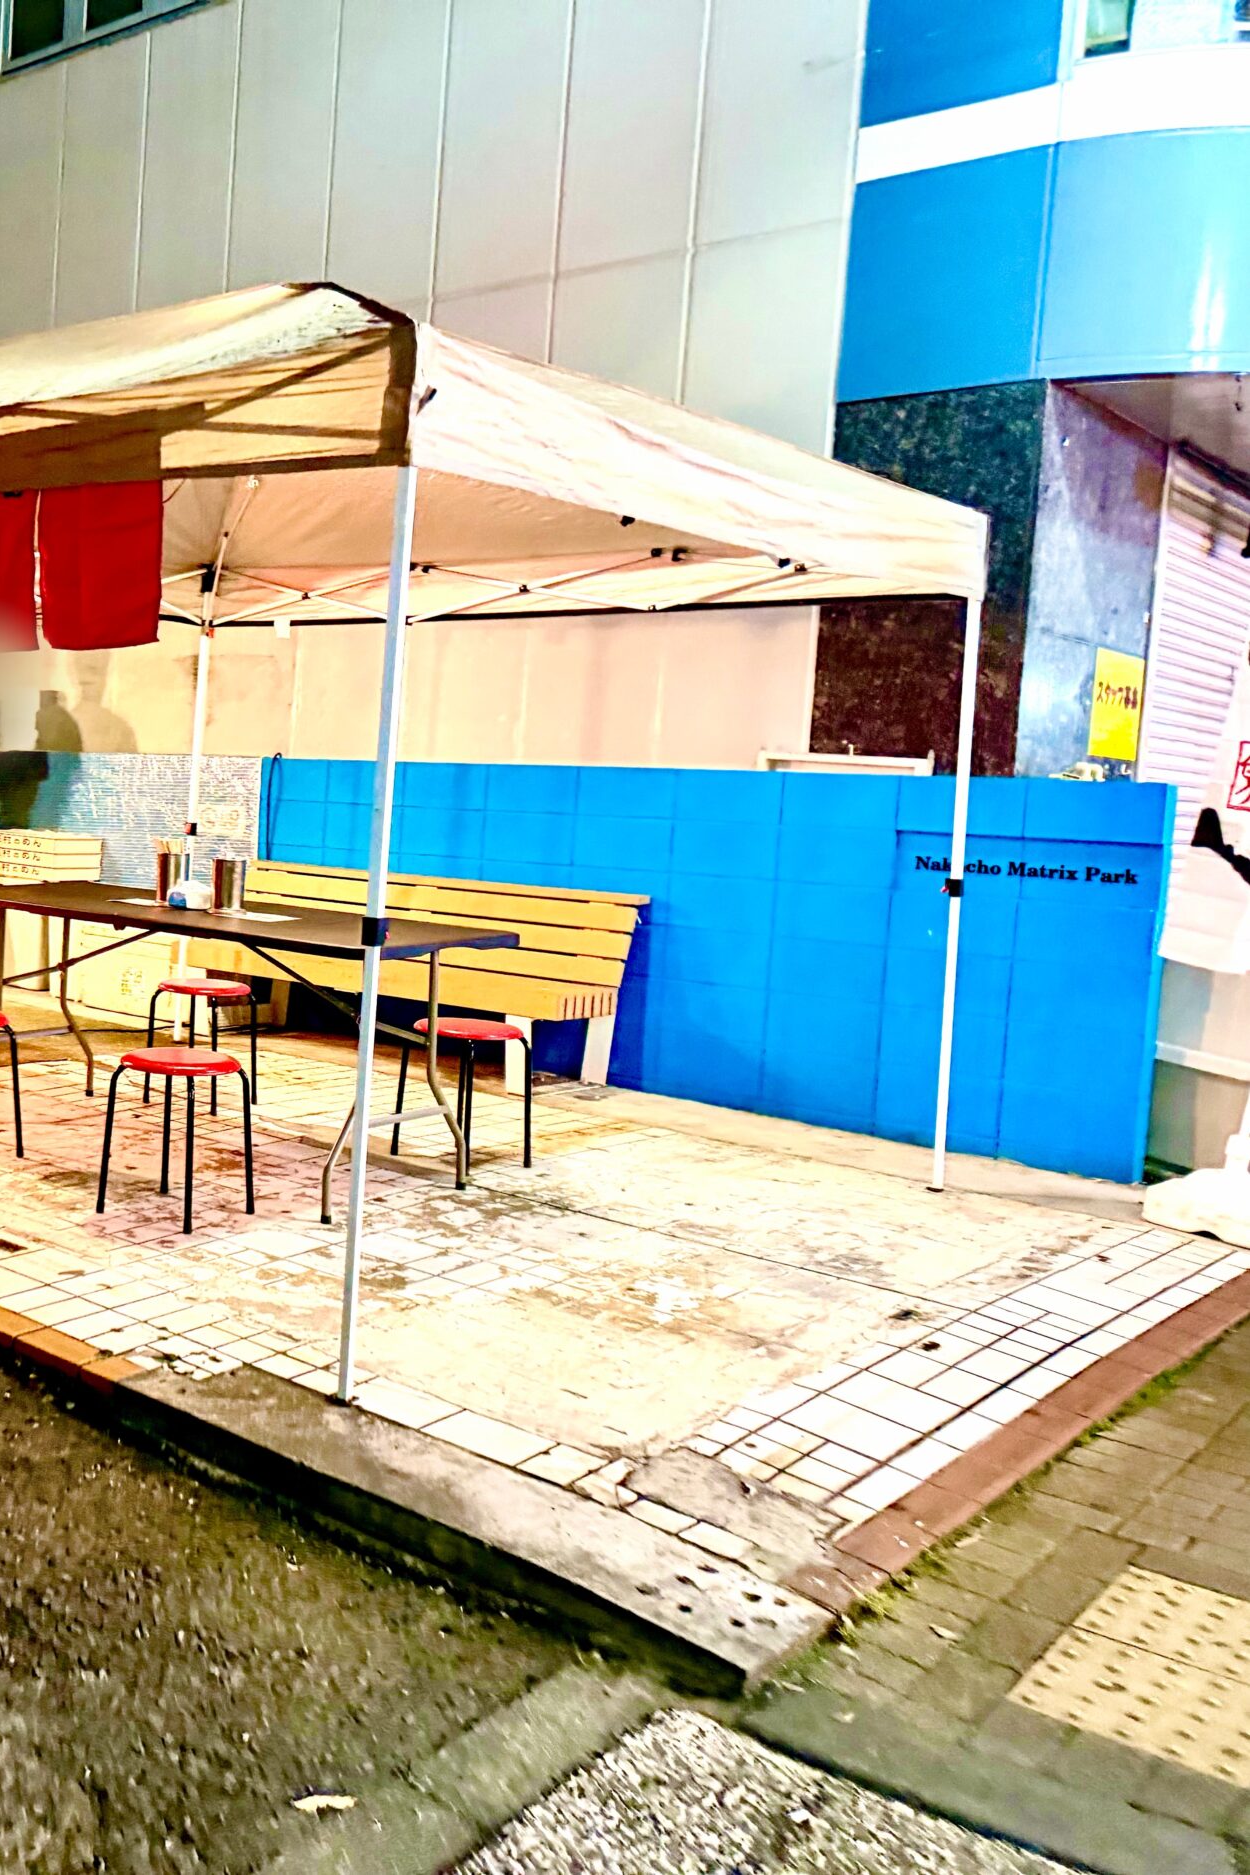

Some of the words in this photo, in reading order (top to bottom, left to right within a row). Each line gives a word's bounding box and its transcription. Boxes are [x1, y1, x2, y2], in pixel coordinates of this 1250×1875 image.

[915, 855, 1002, 876] Nakcho
[1007, 861, 1078, 881] Matrix
[1085, 866, 1139, 885] Park
